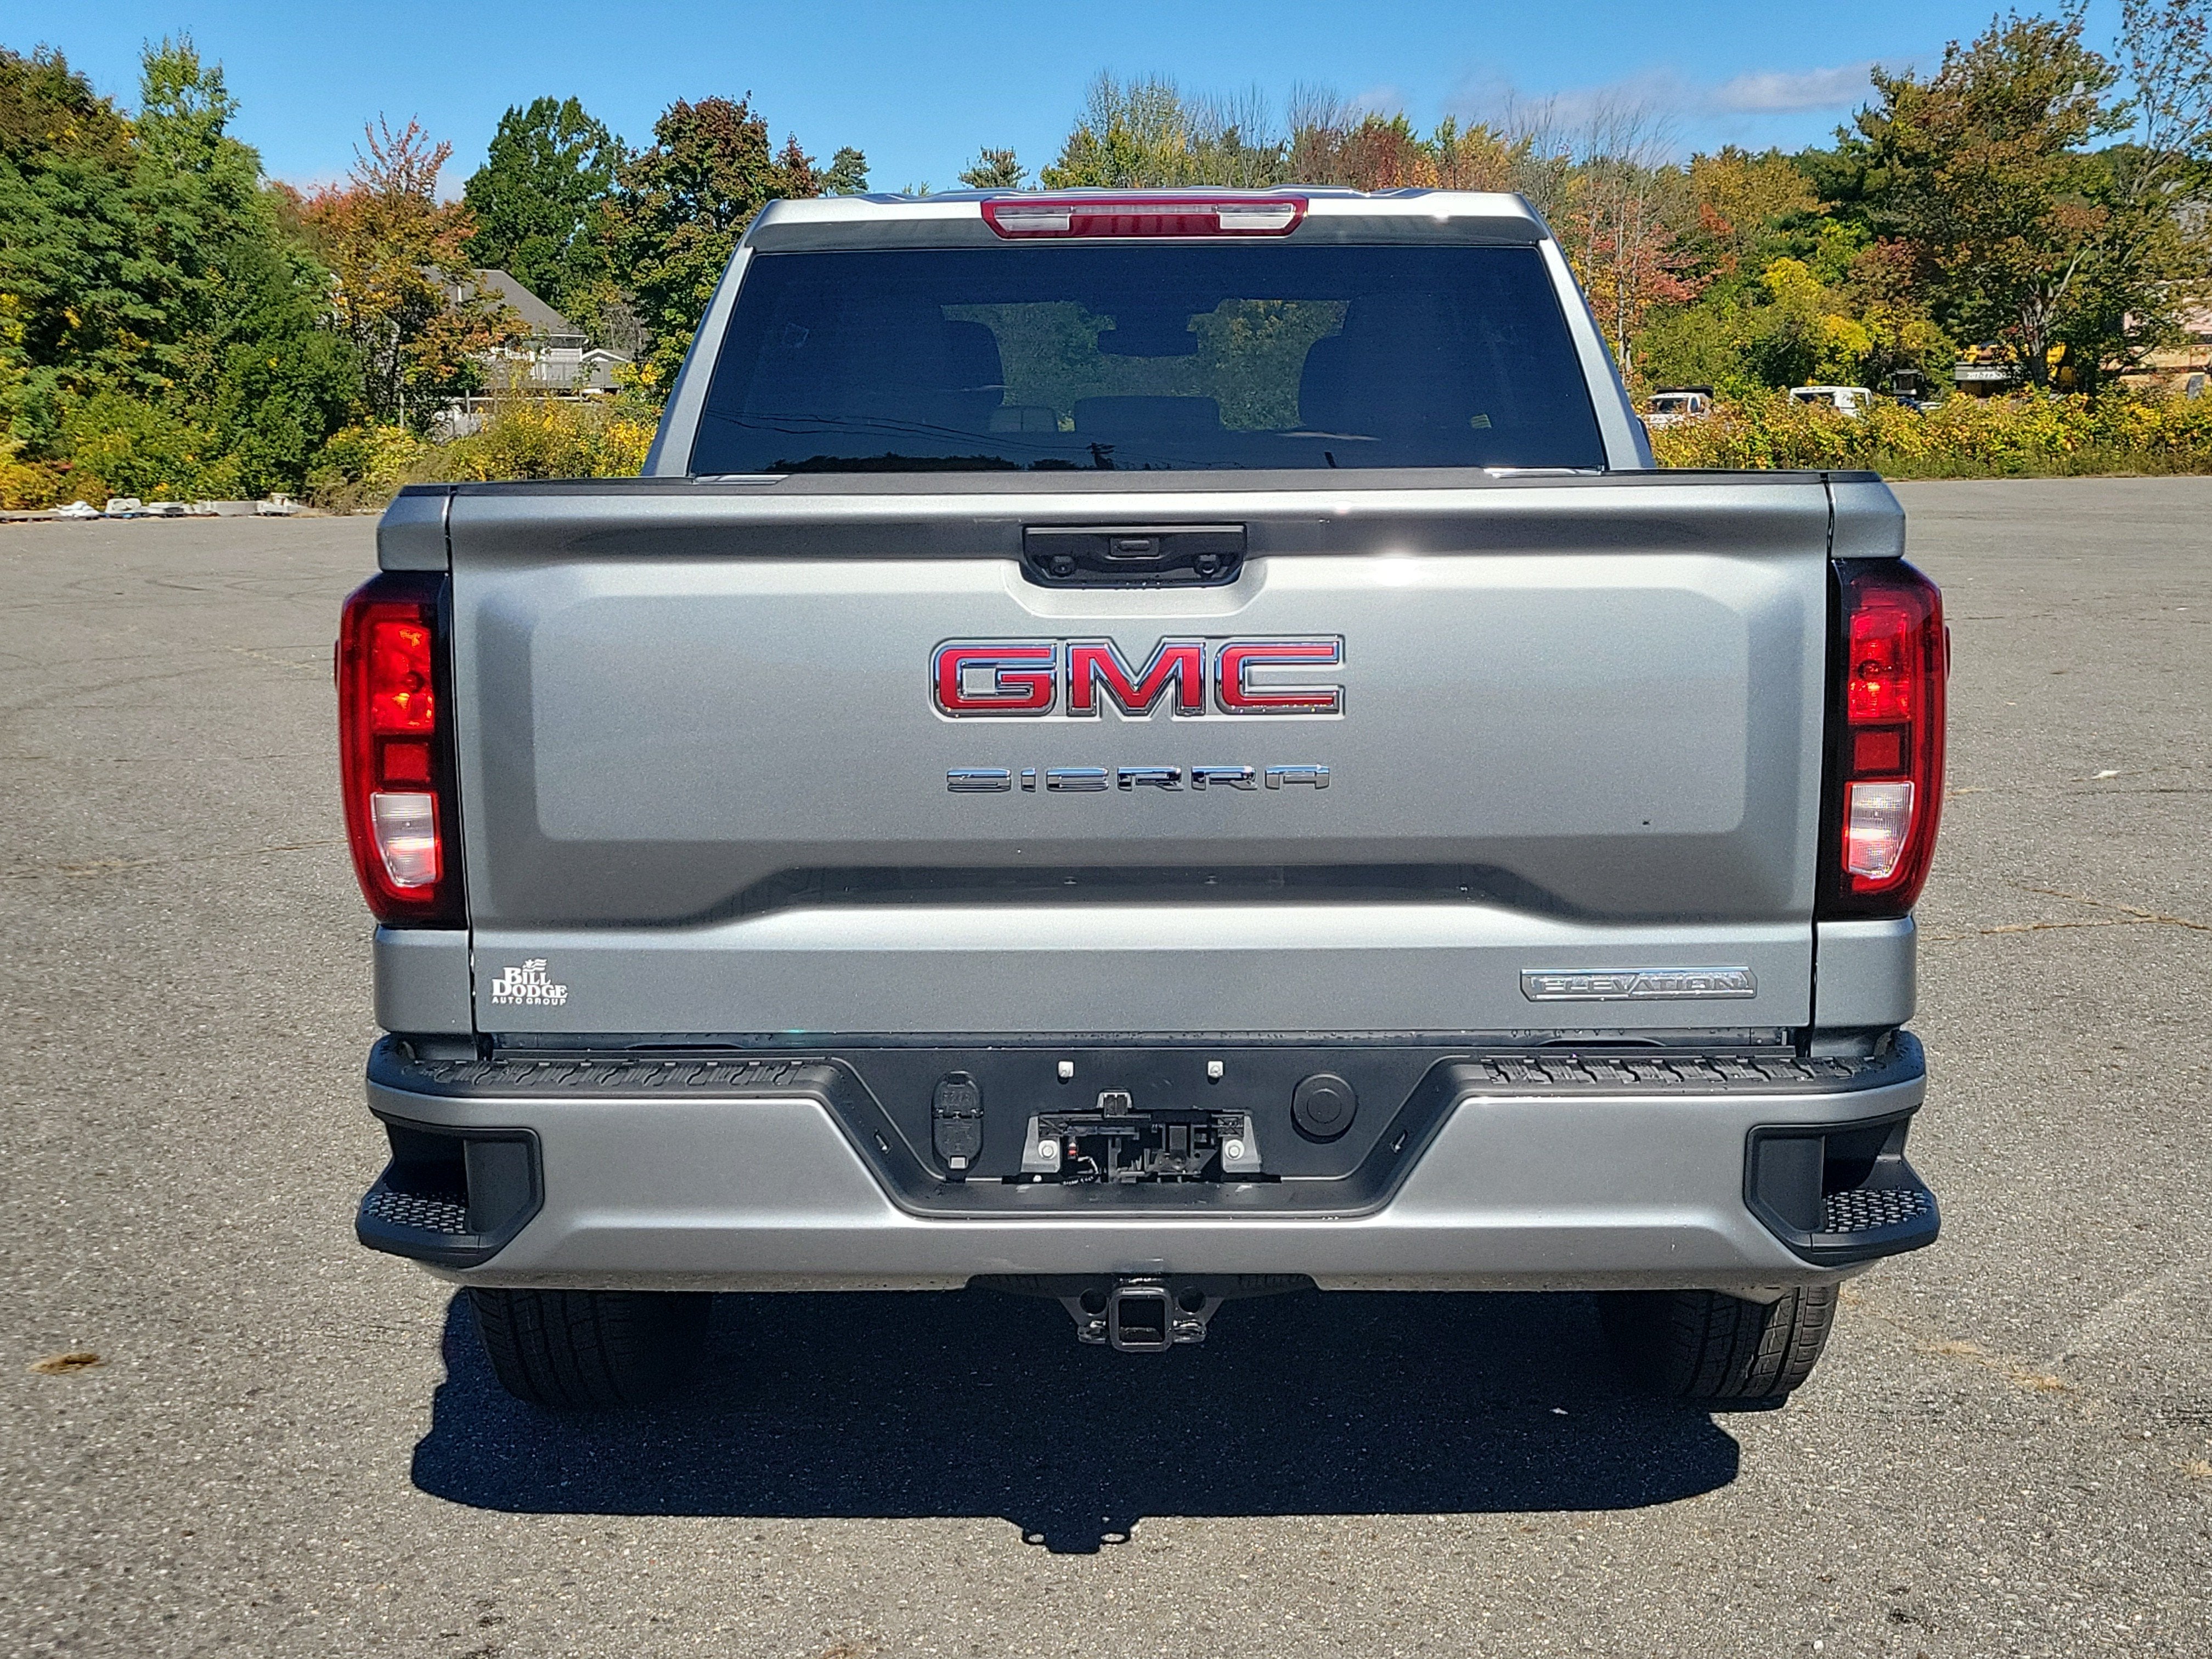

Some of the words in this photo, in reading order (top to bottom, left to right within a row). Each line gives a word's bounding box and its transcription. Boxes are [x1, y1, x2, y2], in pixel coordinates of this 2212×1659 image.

[933, 639, 1342, 718] GMC
[946, 764, 1330, 793] SIERRA
[503, 967, 551, 985] BILL
[1538, 972, 1747, 992] ELEVATION
[492, 979, 568, 998] DODGE
[492, 996, 523, 1005] AUTO
[526, 997, 566, 1006] GROUP
